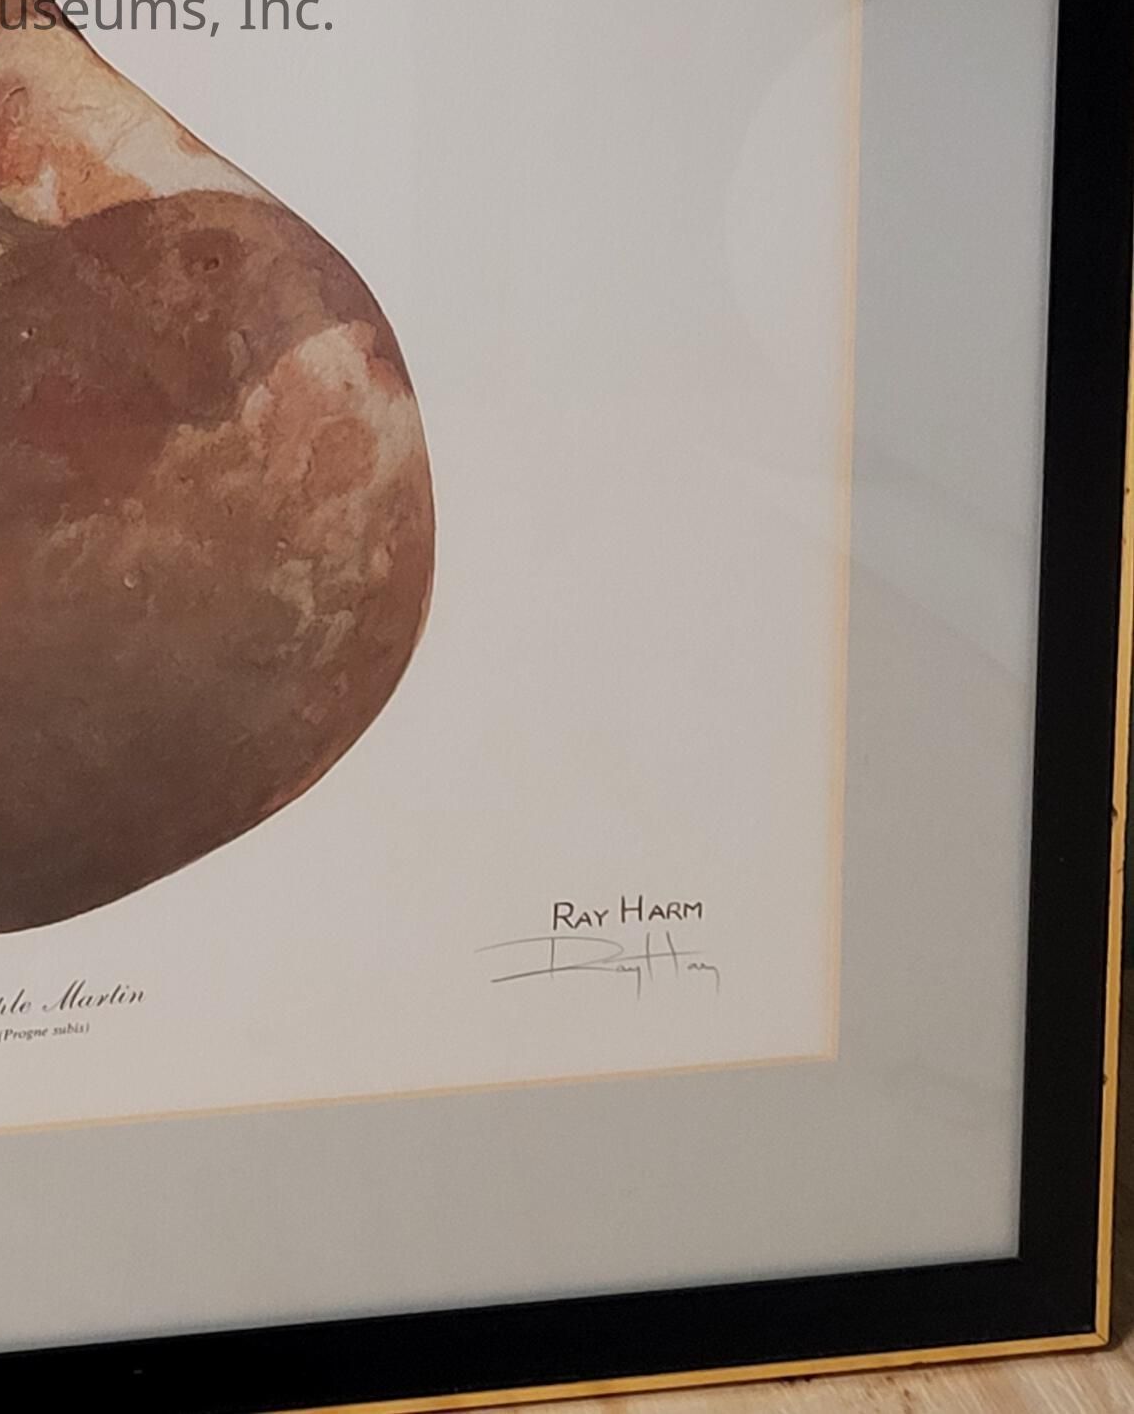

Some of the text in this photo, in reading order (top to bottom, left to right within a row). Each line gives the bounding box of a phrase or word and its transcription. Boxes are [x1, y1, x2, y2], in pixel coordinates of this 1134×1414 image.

[552, 894, 703, 931] RAY HARM
[42, 979, 146, 1011] Martin
[52, 1022, 90, 1036] subis)
